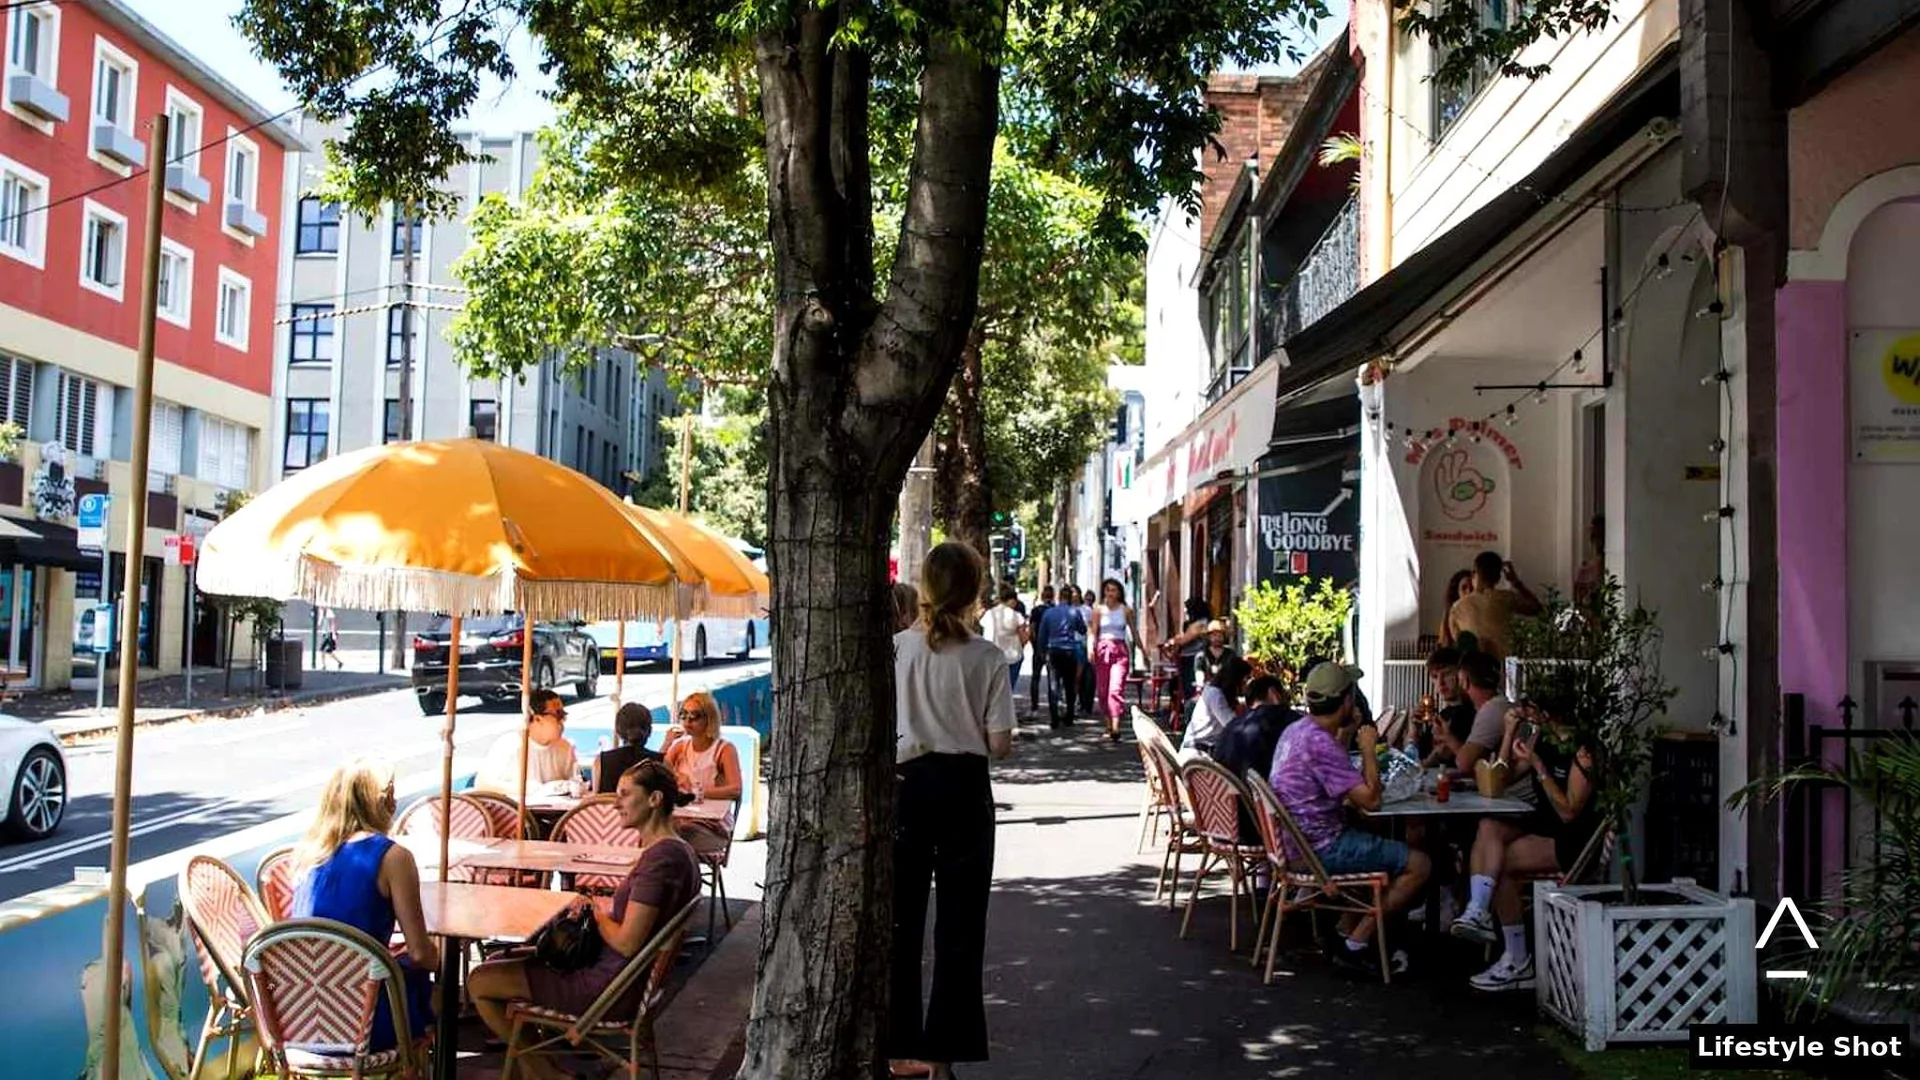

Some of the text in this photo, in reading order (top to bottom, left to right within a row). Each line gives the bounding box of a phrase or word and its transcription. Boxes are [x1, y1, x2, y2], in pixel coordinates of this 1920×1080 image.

[1282, 512, 1328, 534] LONG
[1265, 529, 1355, 551] GOODBYE
[1423, 529, 1498, 541] Sandwich
